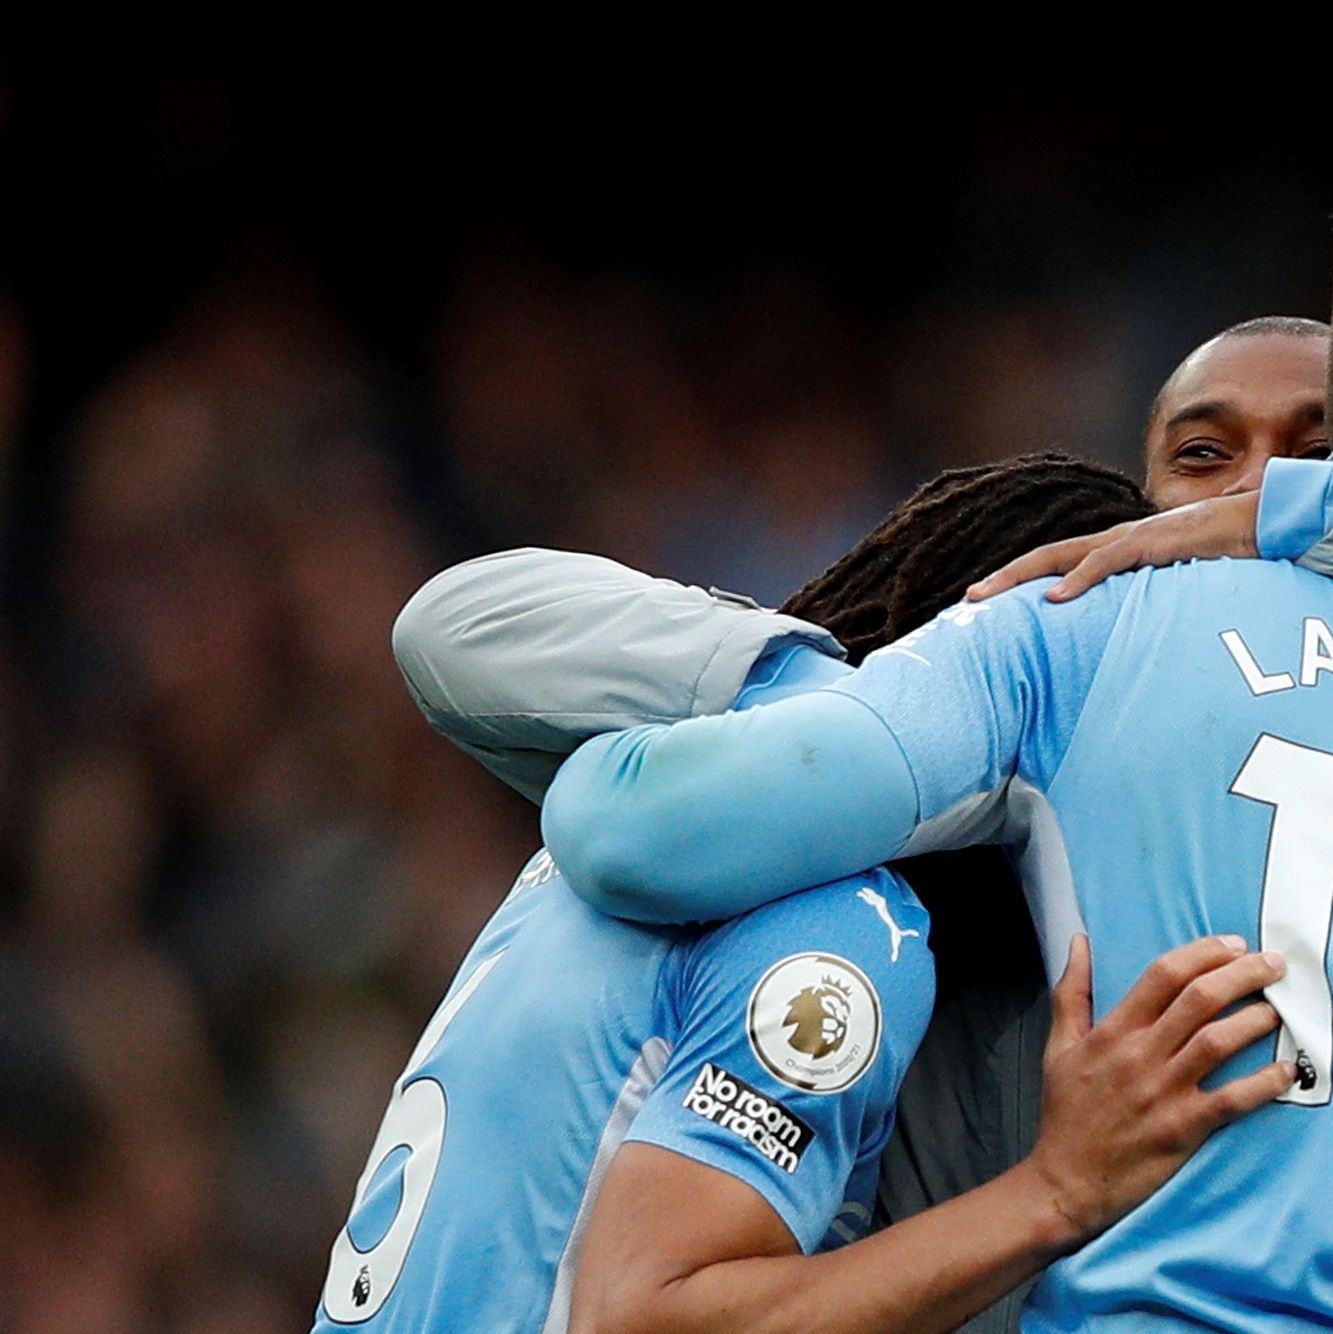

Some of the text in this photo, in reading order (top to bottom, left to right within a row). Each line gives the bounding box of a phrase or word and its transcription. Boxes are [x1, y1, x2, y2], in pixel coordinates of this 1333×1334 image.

[322, 945, 513, 1326] 6
[682, 1085, 799, 1174] for racism
[694, 1062, 802, 1148] No room
